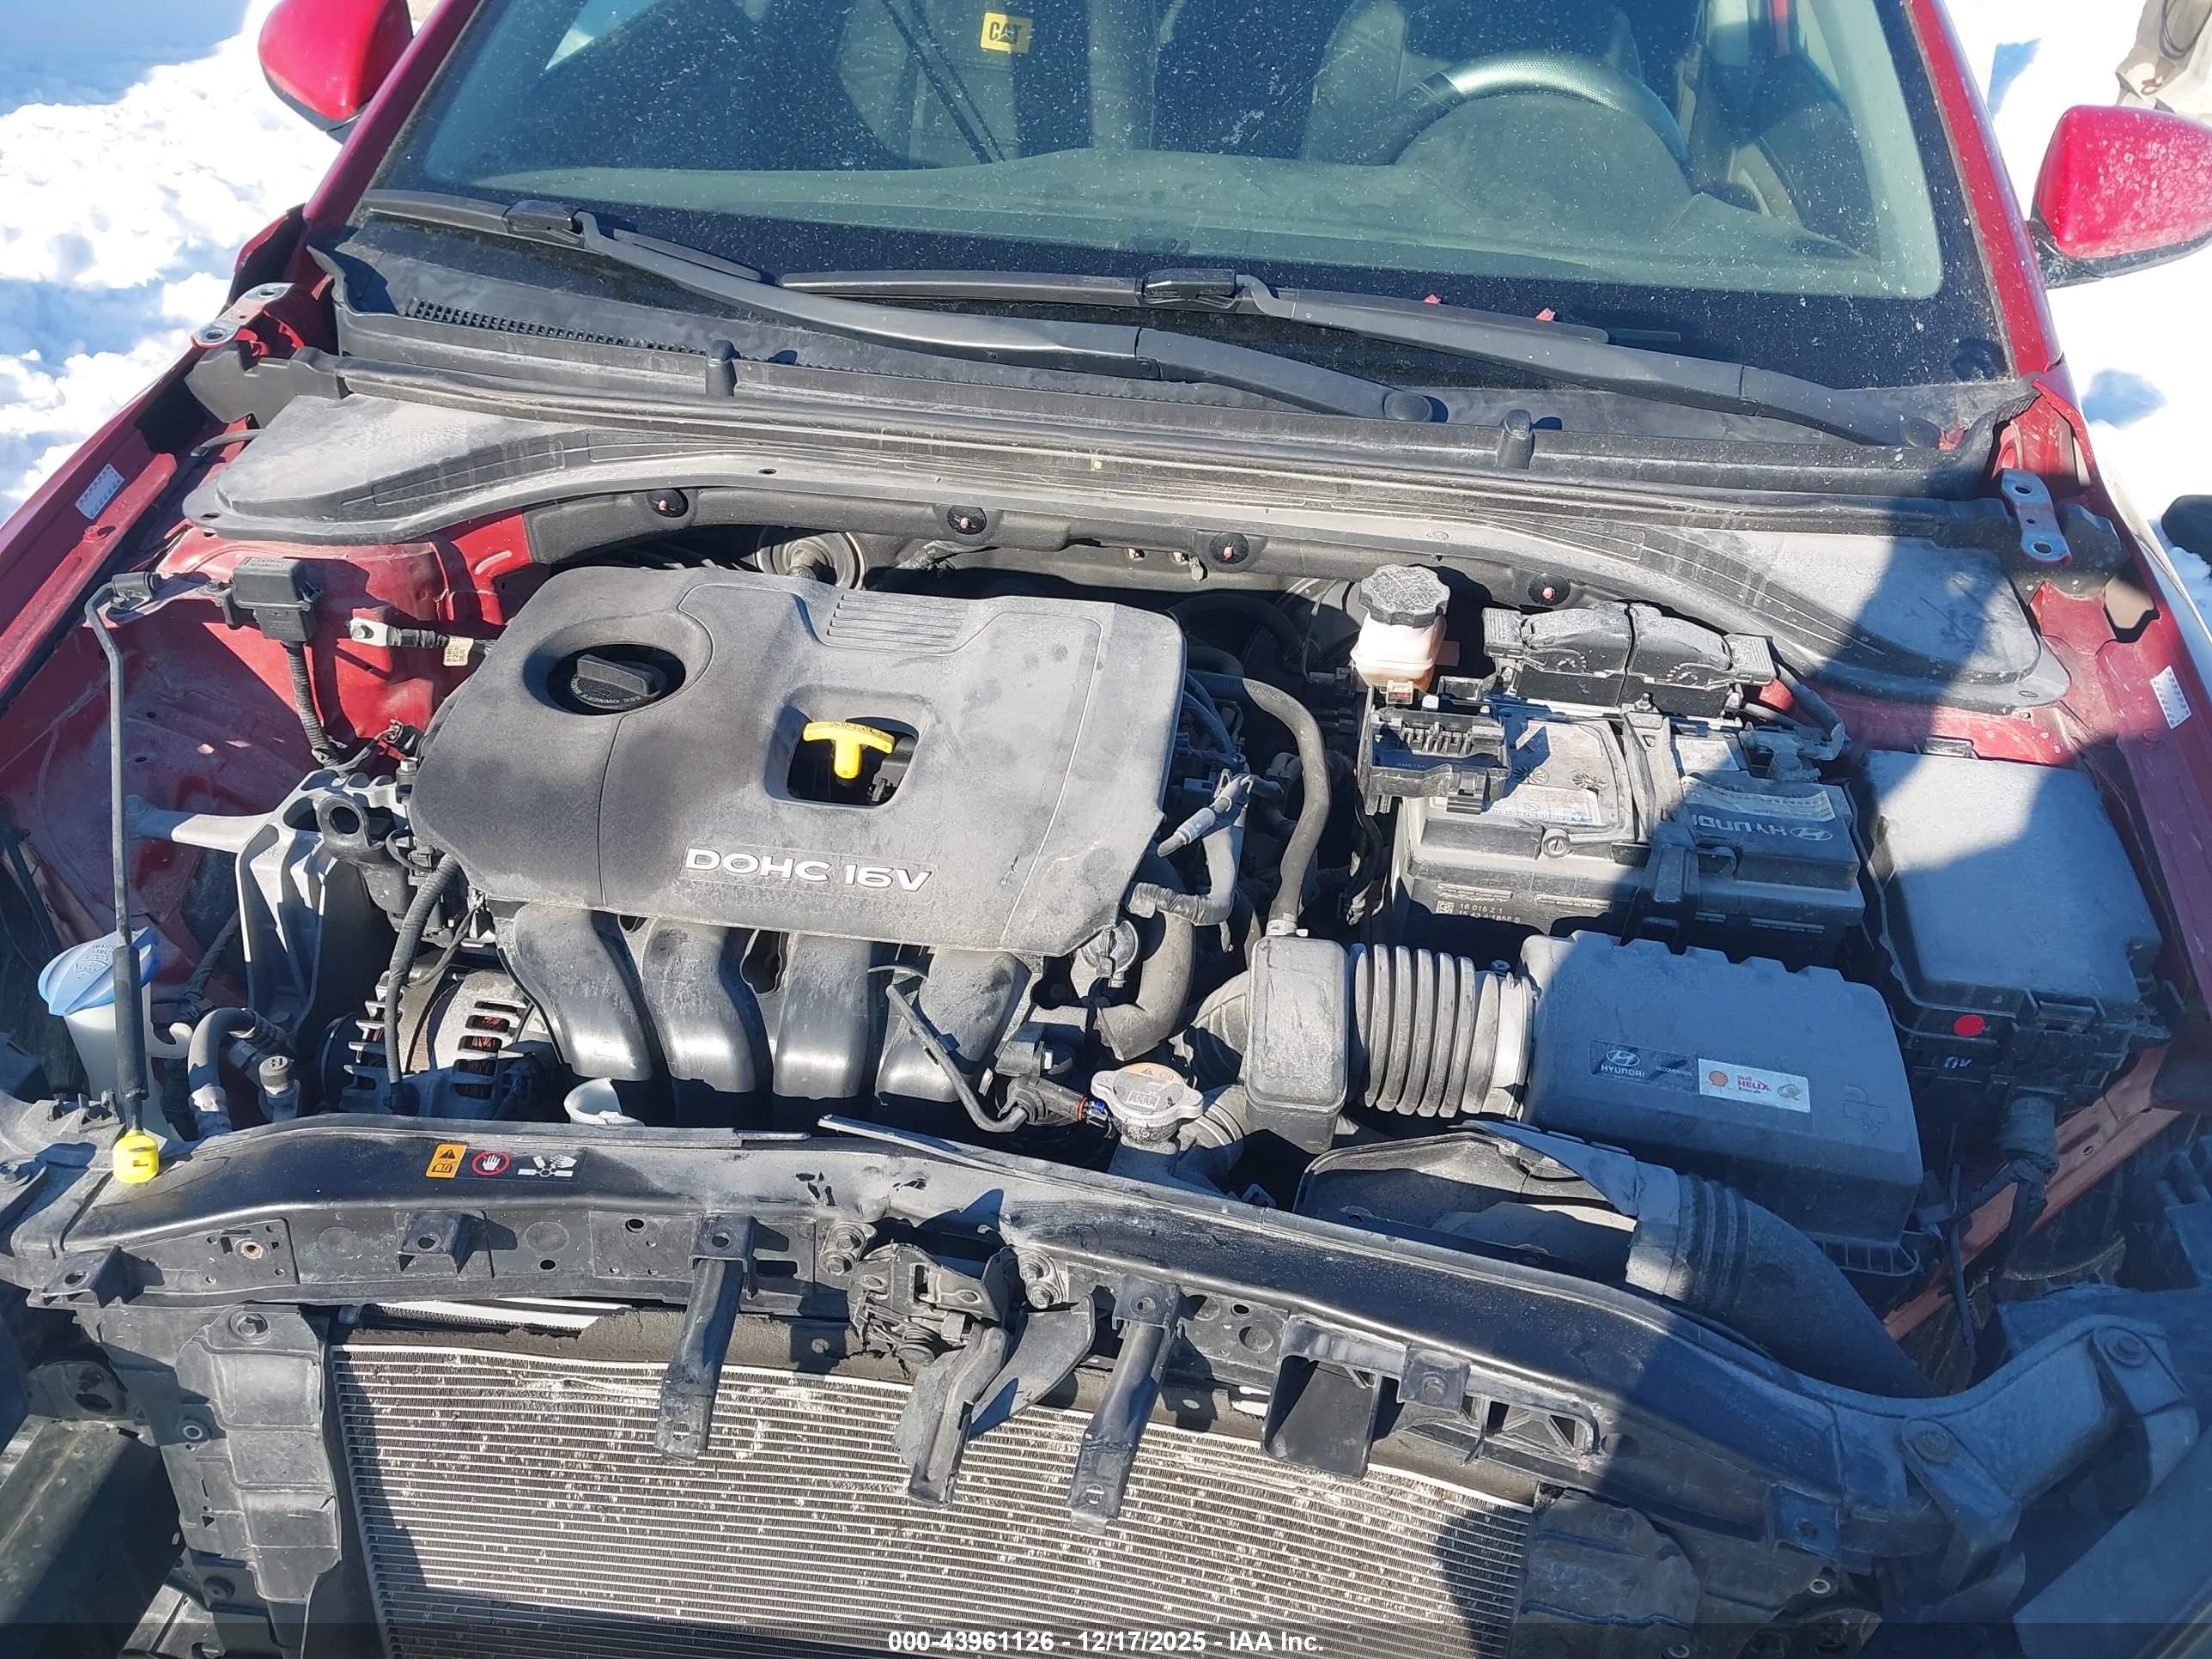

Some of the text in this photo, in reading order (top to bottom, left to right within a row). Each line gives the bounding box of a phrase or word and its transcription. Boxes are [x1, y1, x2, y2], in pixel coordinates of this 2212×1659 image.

[988, 21, 1022, 45] CAT
[685, 848, 933, 892] DOHC 16V
[1601, 1064, 1645, 1079] HYUNDAI
[1737, 1079, 1771, 1092] HELIX
